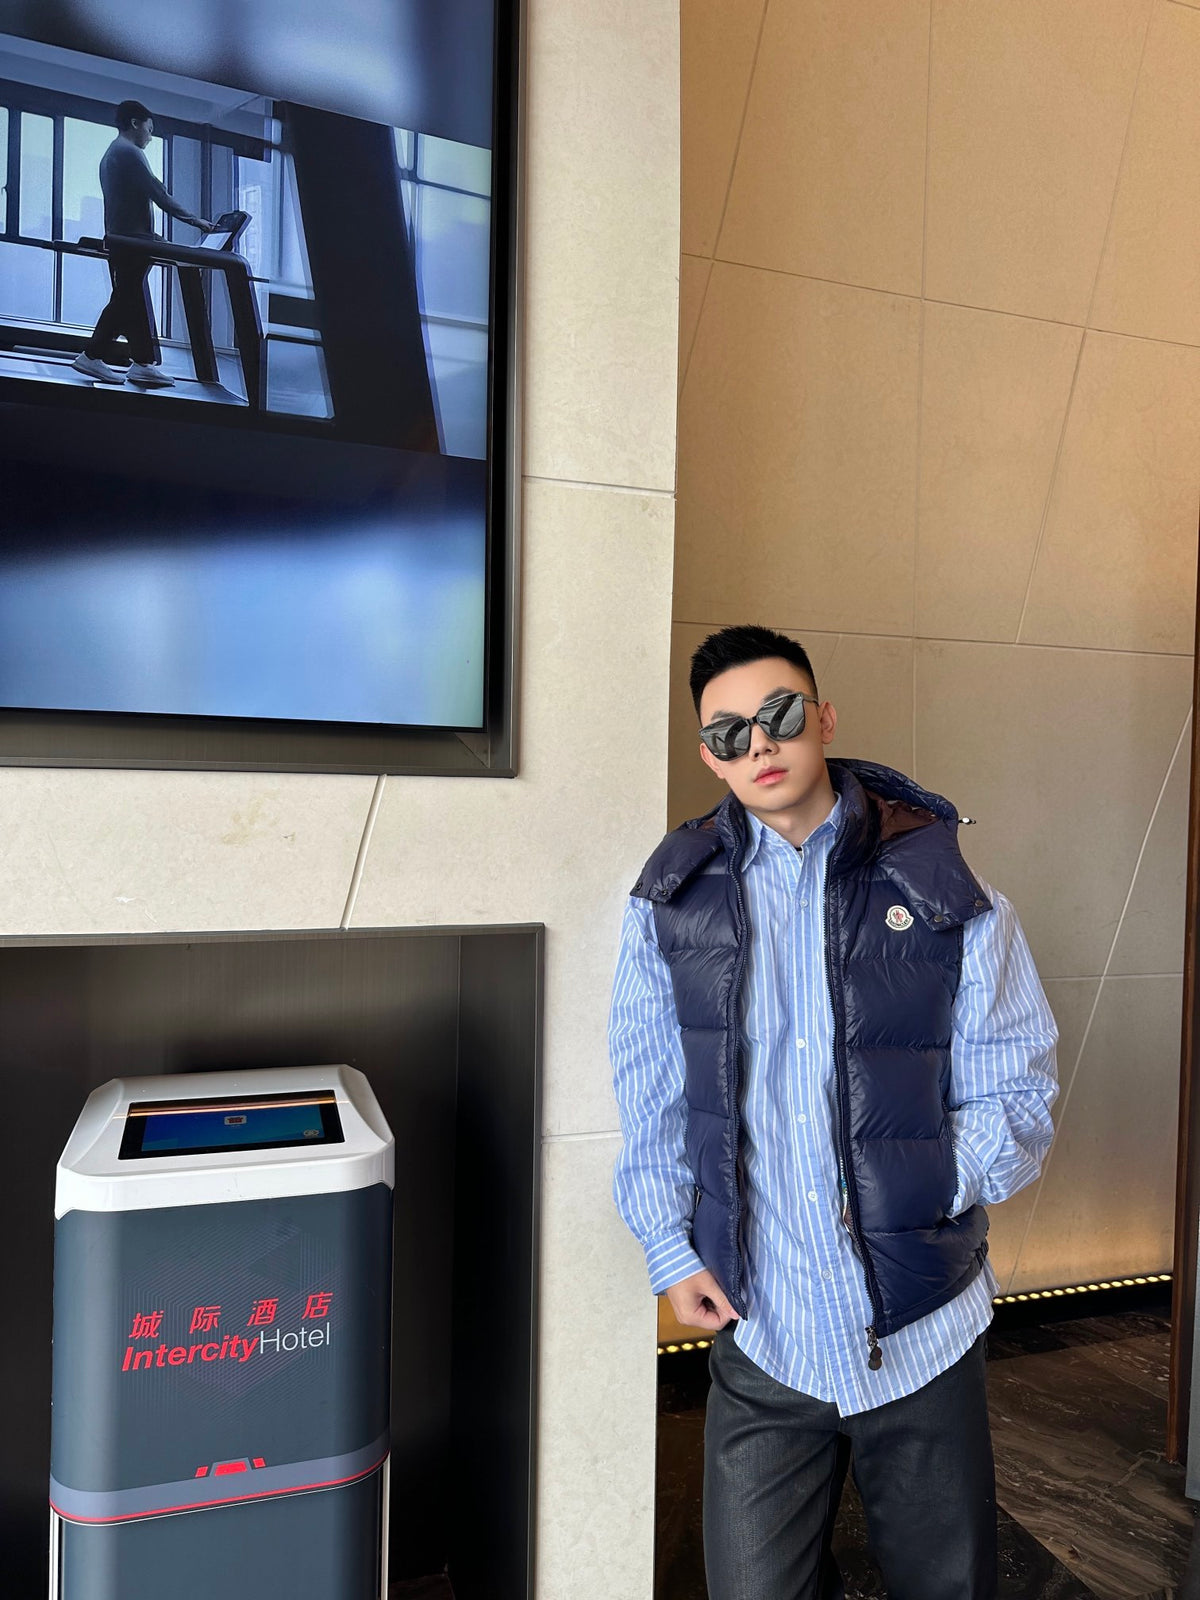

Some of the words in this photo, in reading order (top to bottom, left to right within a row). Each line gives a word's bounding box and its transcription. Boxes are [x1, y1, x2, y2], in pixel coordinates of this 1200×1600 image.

[128, 1291, 333, 1340] 城际酒店
[121, 1321, 331, 1372] IntercityHotel
